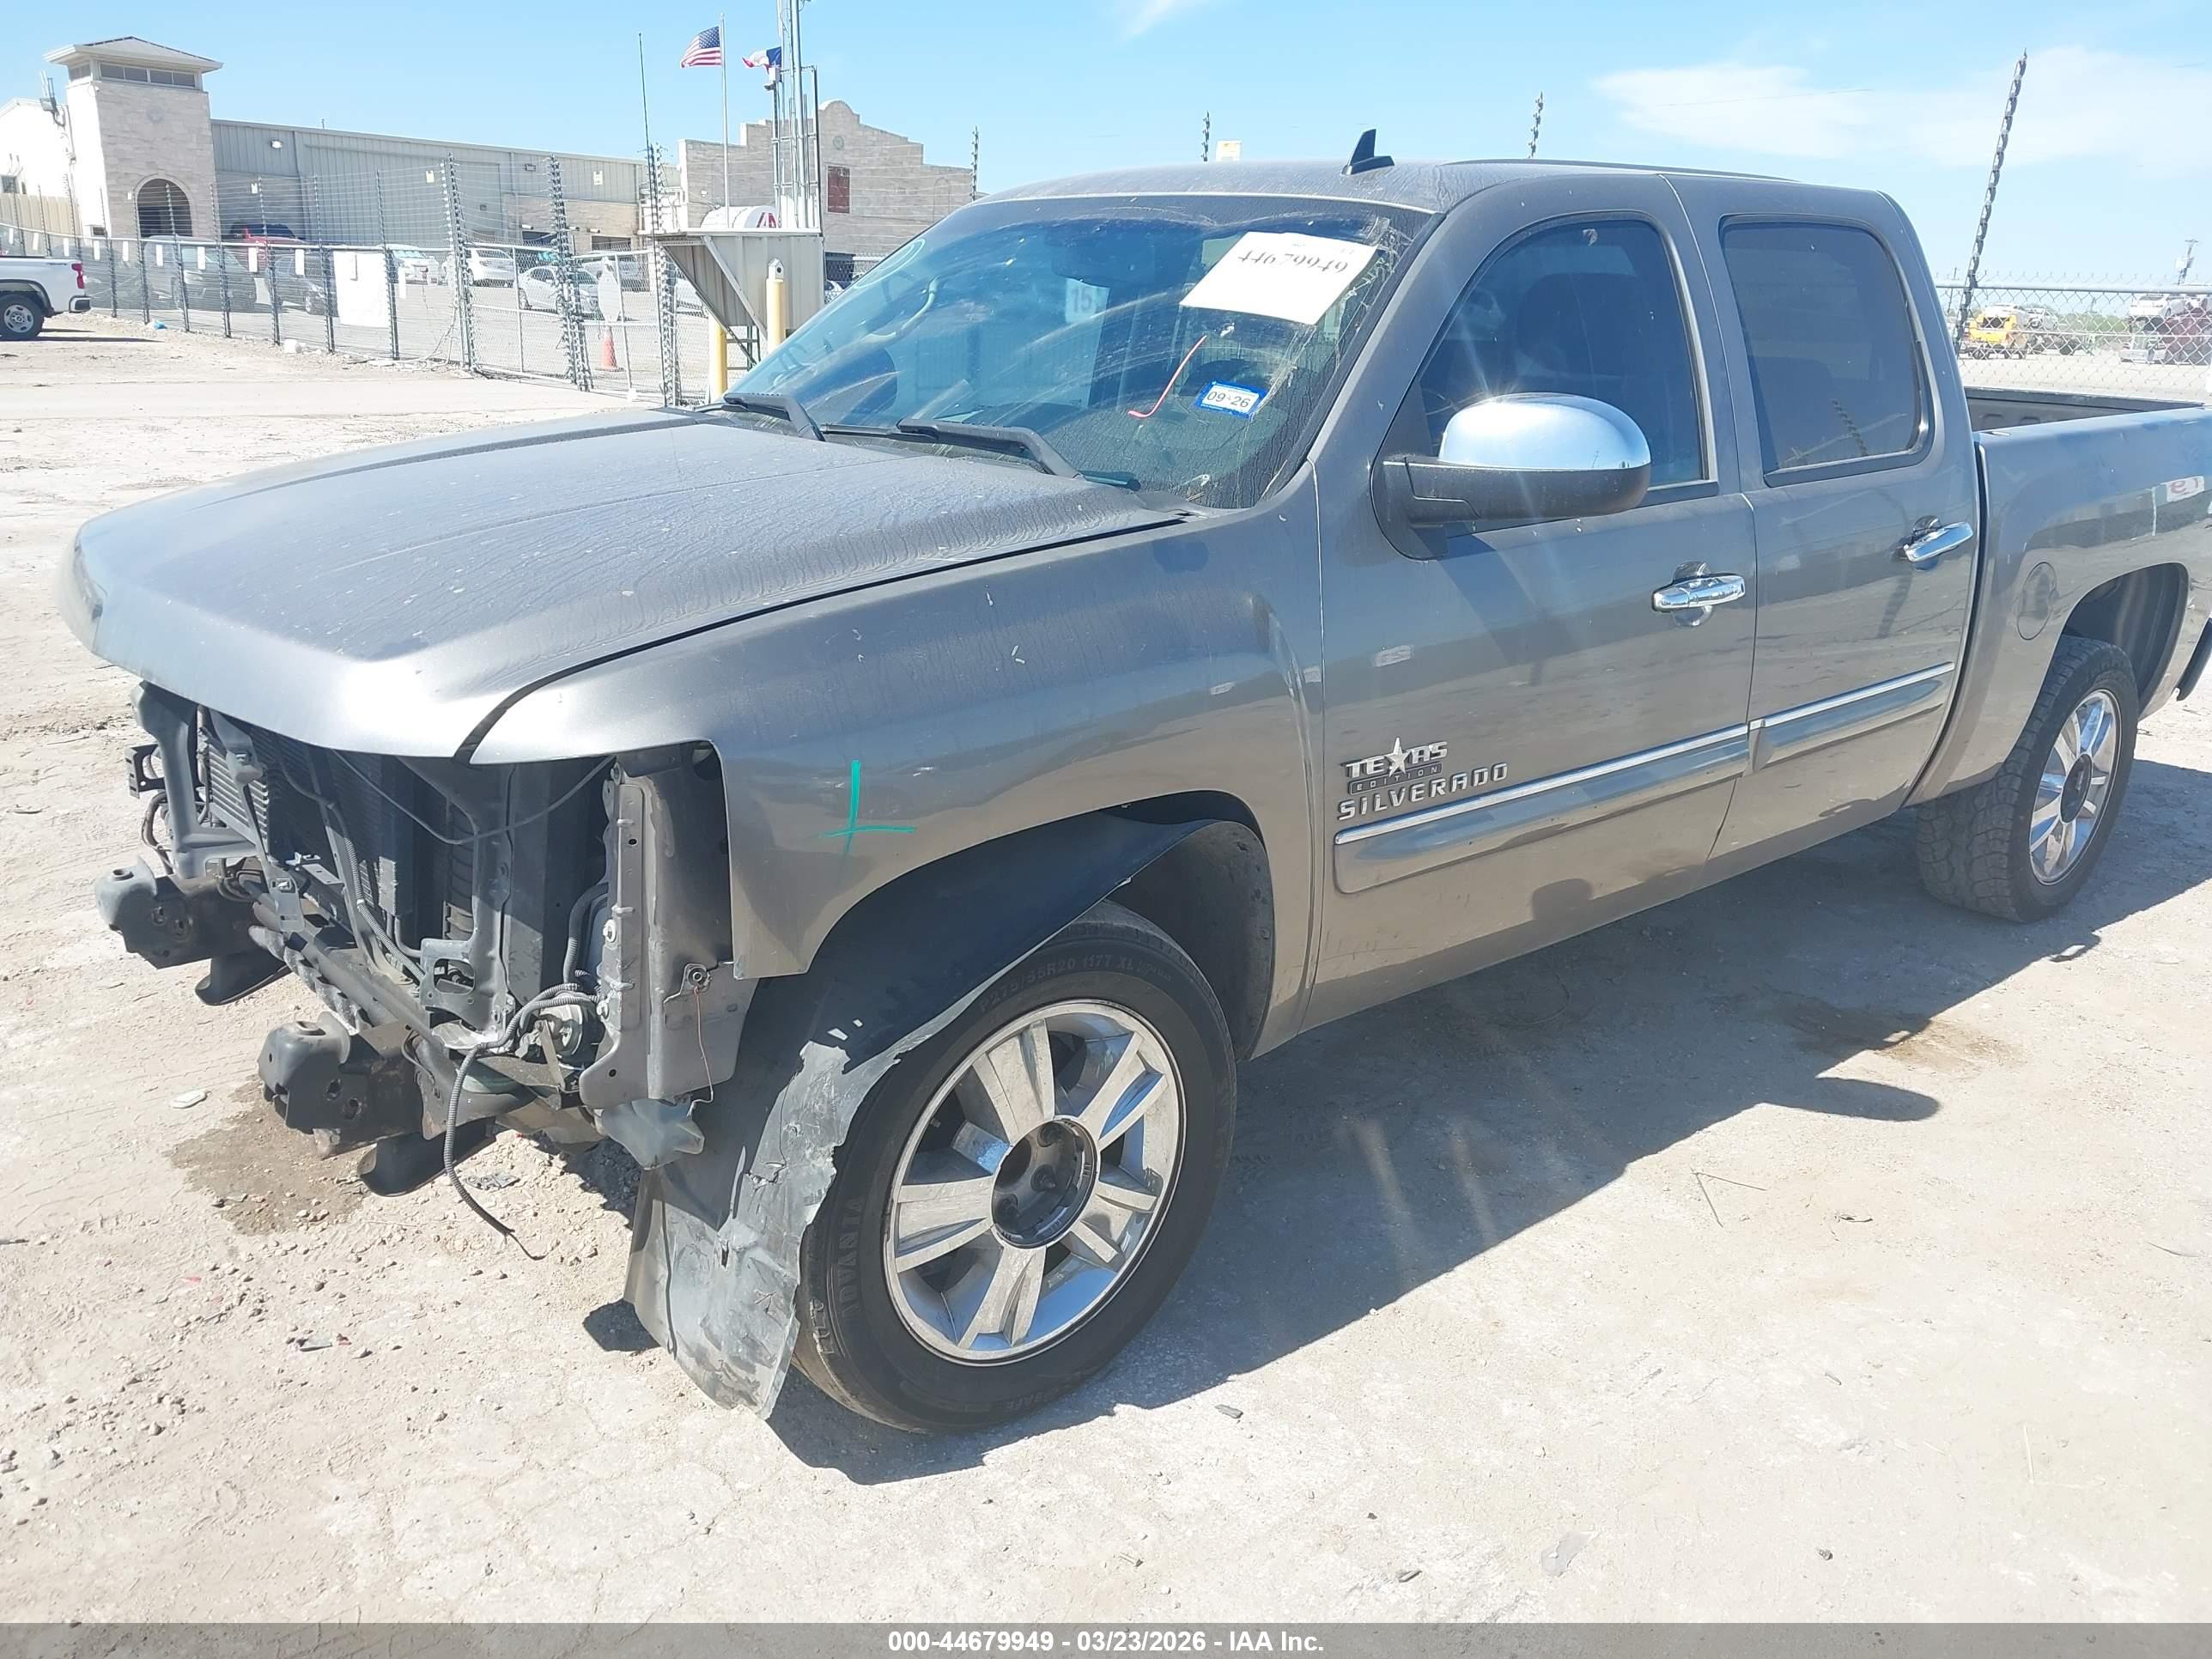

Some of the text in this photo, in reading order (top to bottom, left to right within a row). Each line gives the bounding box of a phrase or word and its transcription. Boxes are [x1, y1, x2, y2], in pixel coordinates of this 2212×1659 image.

[1206, 391, 1226, 403] 09
[1231, 396, 1250, 408] 26
[1345, 740, 1449, 779] TEXAS
[1338, 763, 1509, 821] SILVERADO
[1356, 766, 1438, 791] EDITION
